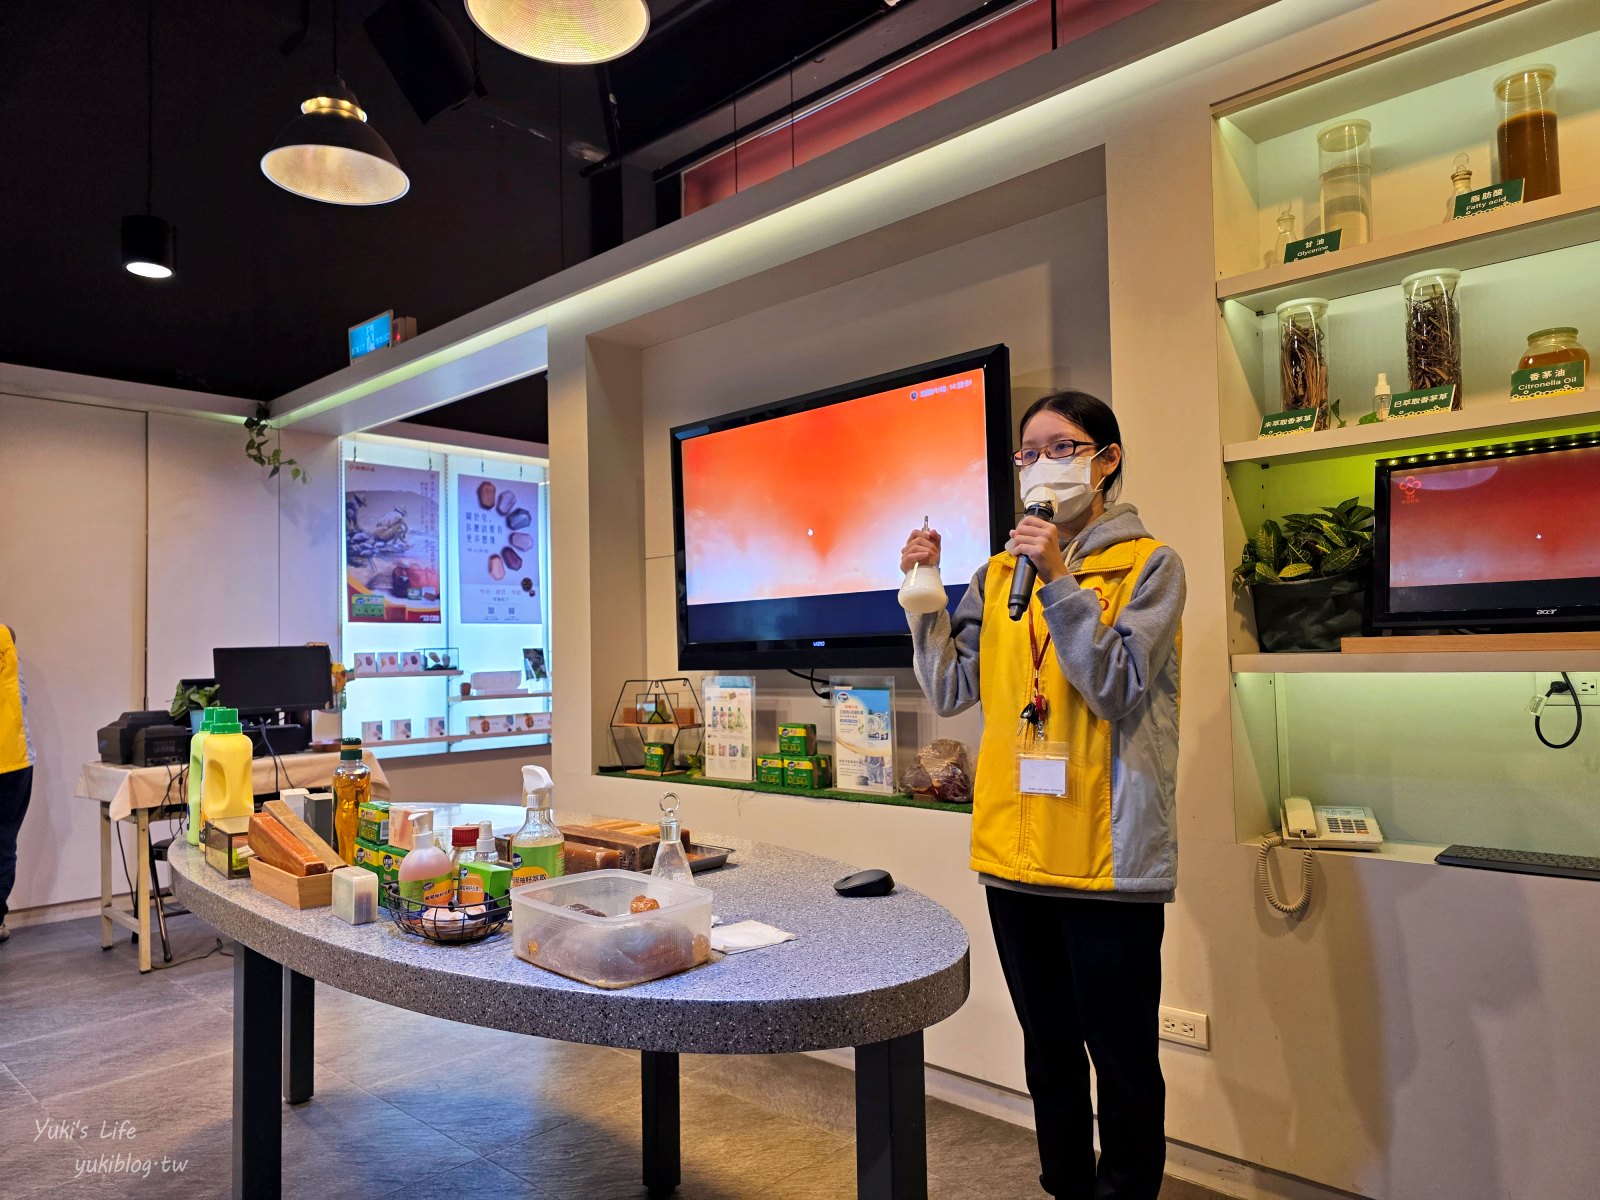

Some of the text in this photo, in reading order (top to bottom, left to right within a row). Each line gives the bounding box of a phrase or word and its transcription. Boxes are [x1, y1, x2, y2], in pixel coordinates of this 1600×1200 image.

[1470, 188, 1503, 203] 脂肪酸
[1465, 196, 1507, 211] Fatty acid
[1305, 238, 1325, 248] 甘油
[1297, 245, 1329, 257] Glycerine
[1529, 368, 1566, 381] 香茅油
[1518, 376, 1577, 391] Citronella Oil
[1536, 608, 1558, 616] acer
